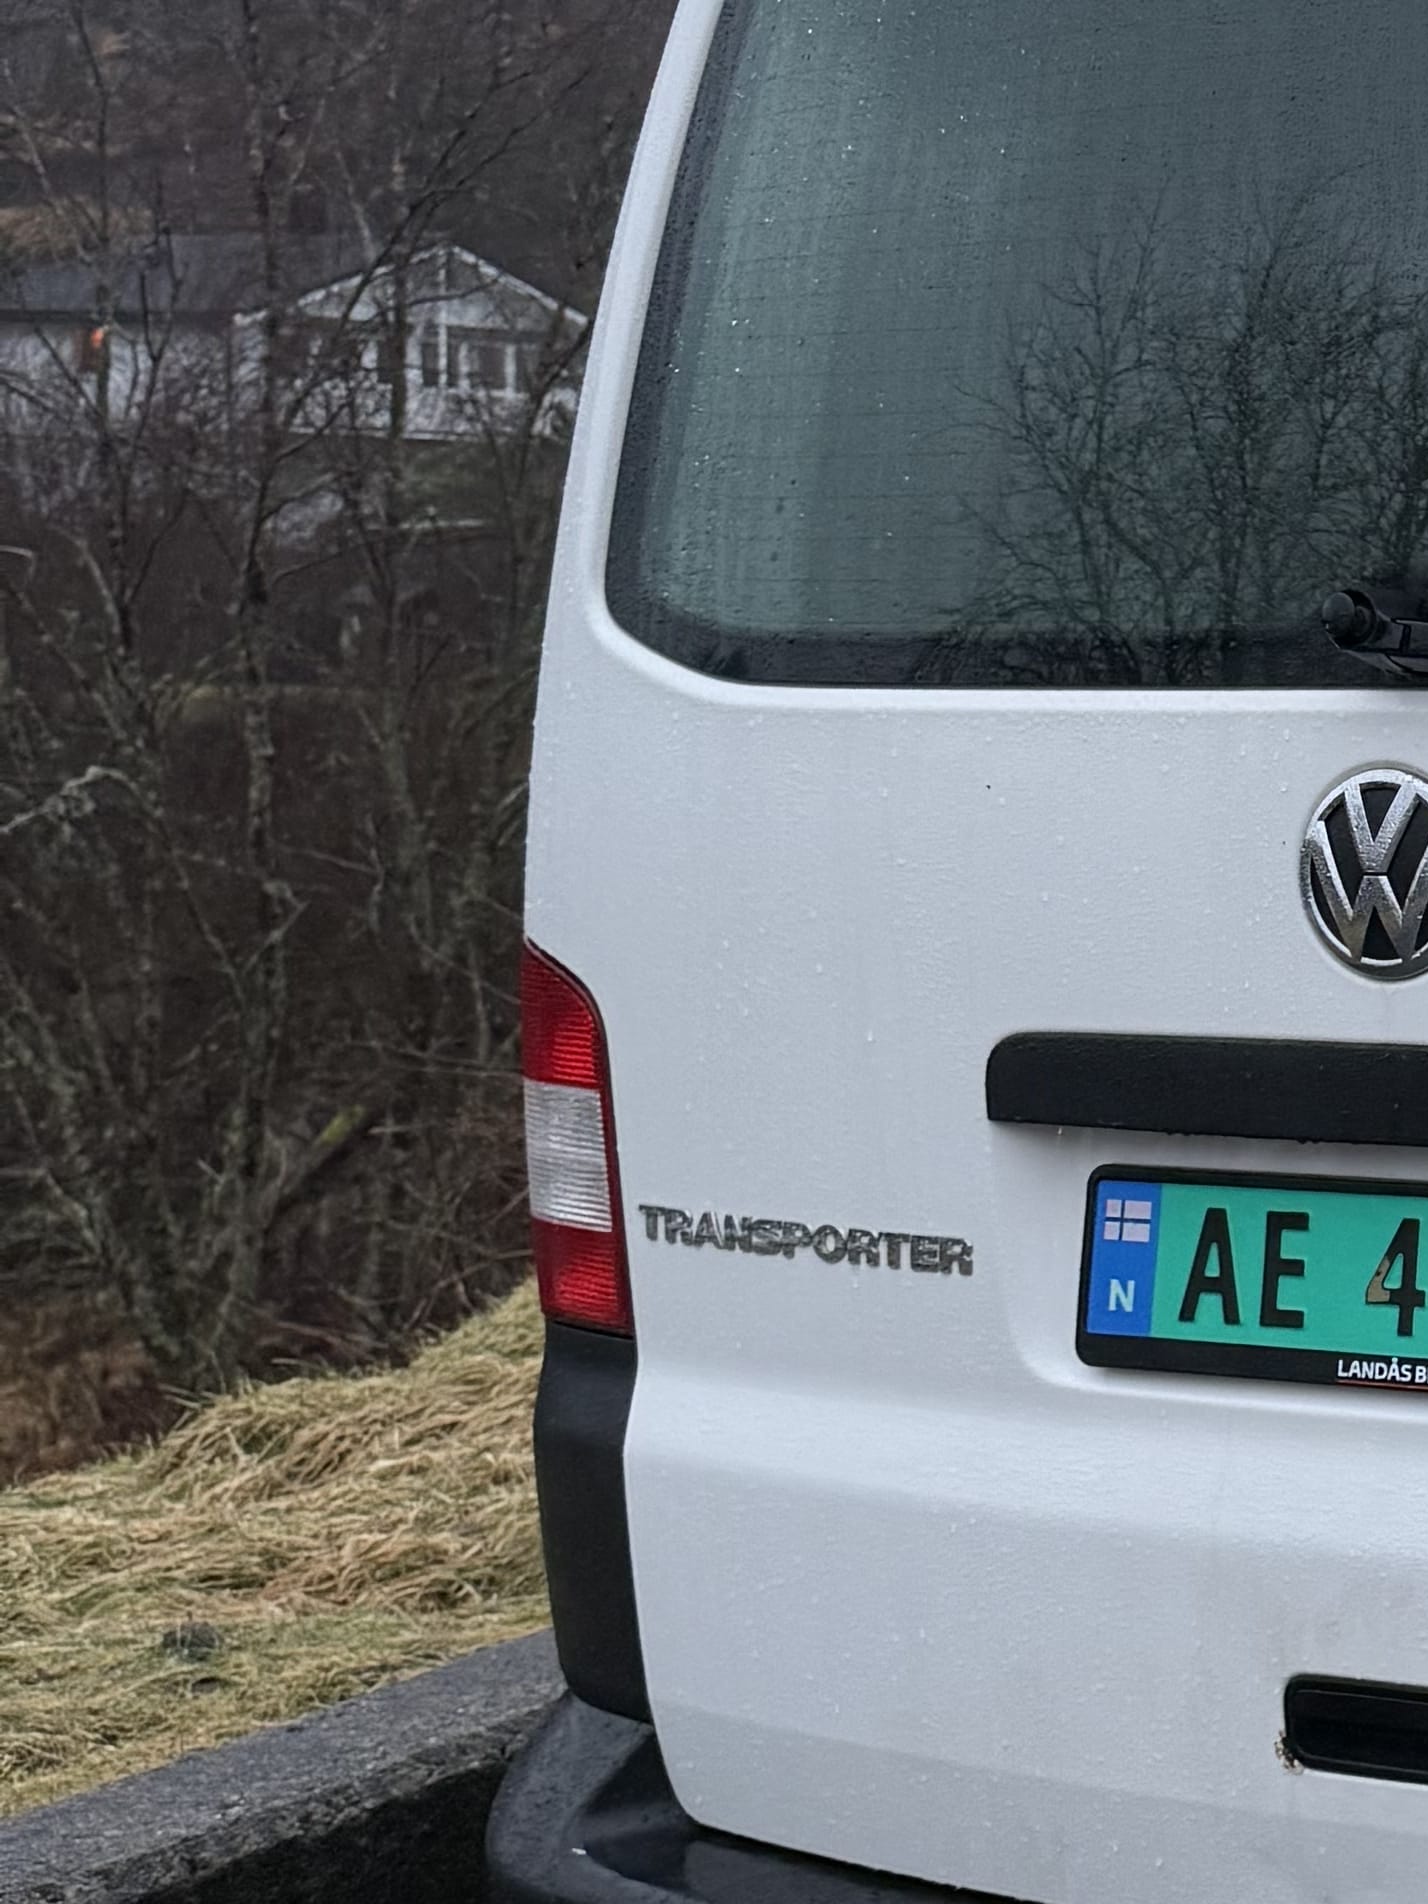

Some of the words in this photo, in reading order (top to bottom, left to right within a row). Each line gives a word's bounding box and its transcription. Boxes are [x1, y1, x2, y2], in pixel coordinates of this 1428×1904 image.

[638, 1203, 974, 1276] TRANSPORTER
[1178, 1206, 1310, 1328] AE
[1108, 1279, 1135, 1313] N
[1337, 1357, 1412, 1382] LANDÅS
